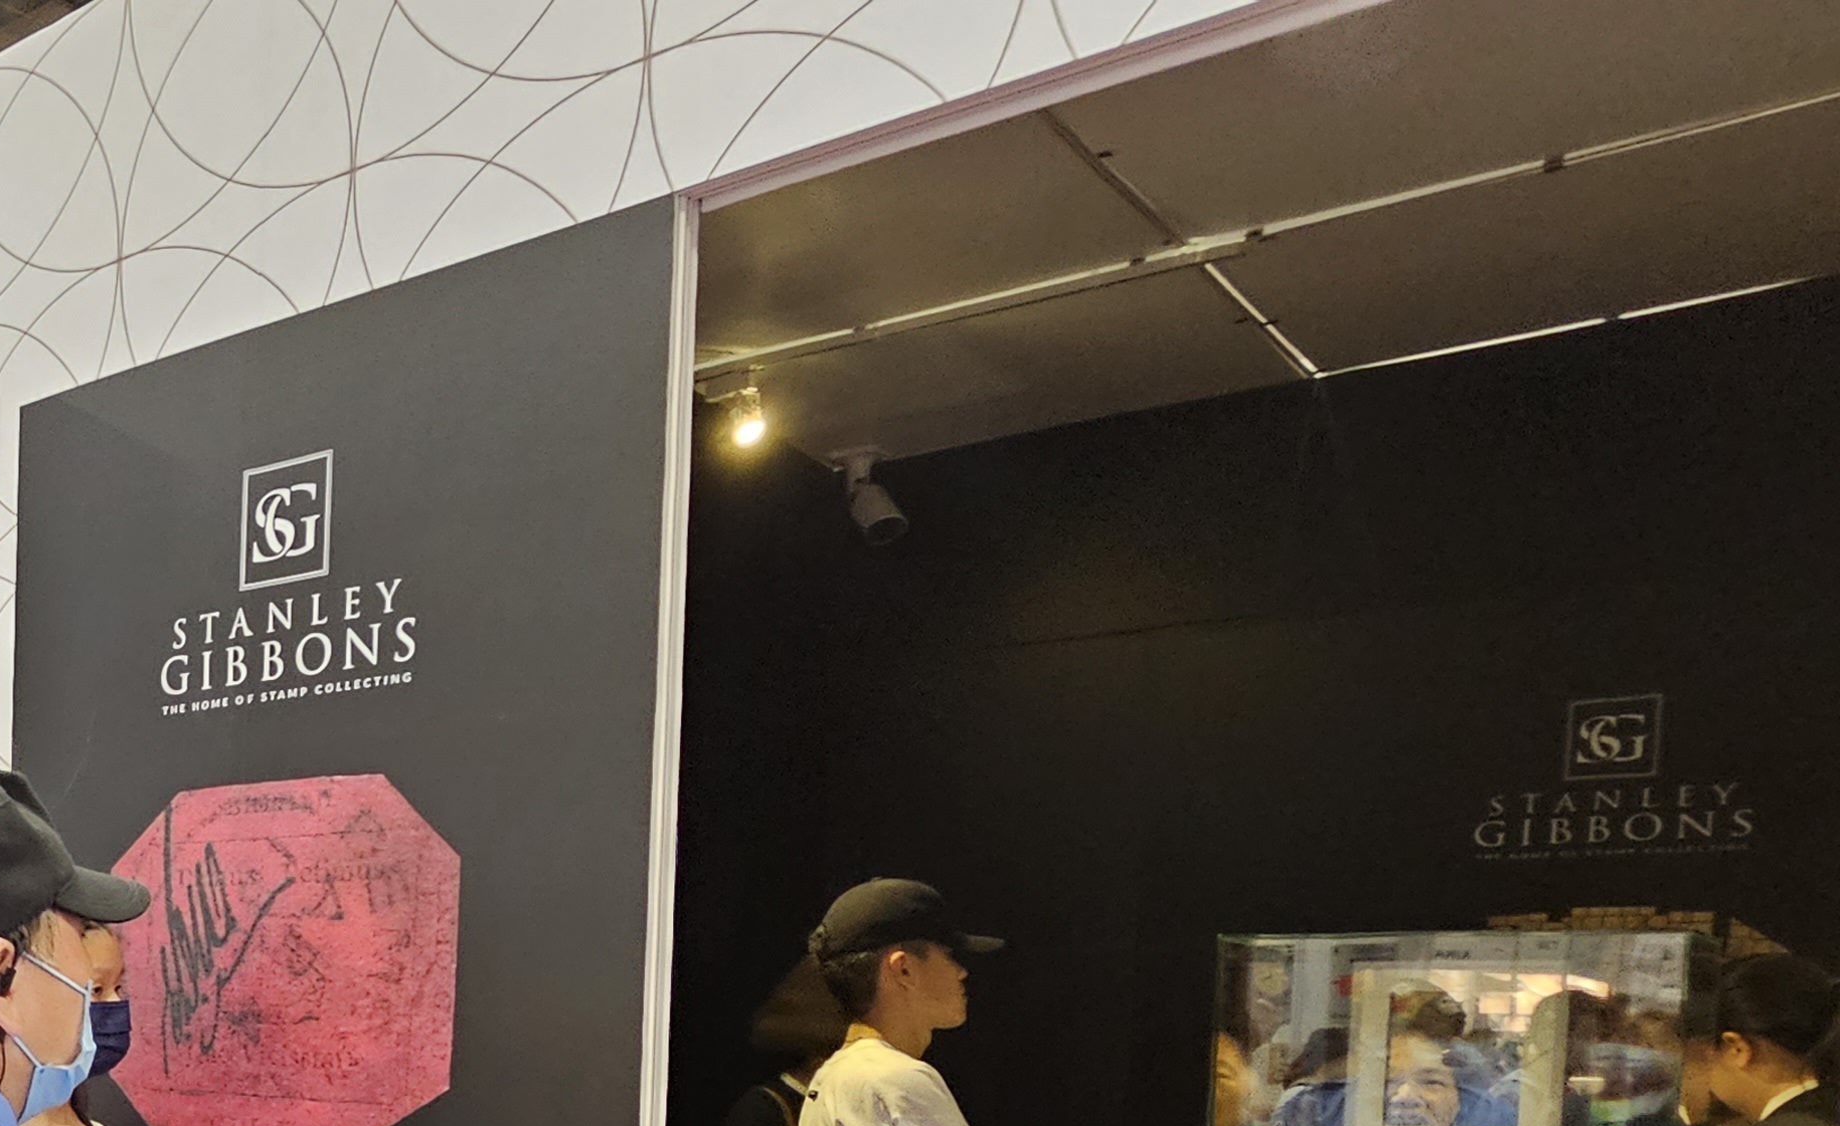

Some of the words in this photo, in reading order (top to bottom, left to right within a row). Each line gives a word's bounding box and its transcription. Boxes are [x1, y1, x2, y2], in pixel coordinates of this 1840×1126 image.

[252, 483, 321, 563] SG
[172, 578, 402, 650] STANLEY
[160, 616, 416, 696] GIBBONS
[161, 704, 186, 716] THE
[191, 697, 229, 712] HOME
[234, 694, 254, 706] OF
[259, 686, 308, 702] STAMP
[314, 671, 413, 696] COLLECTING
[1473, 808, 1754, 848] GIBBONS
[1488, 782, 1740, 818] STANLEY
